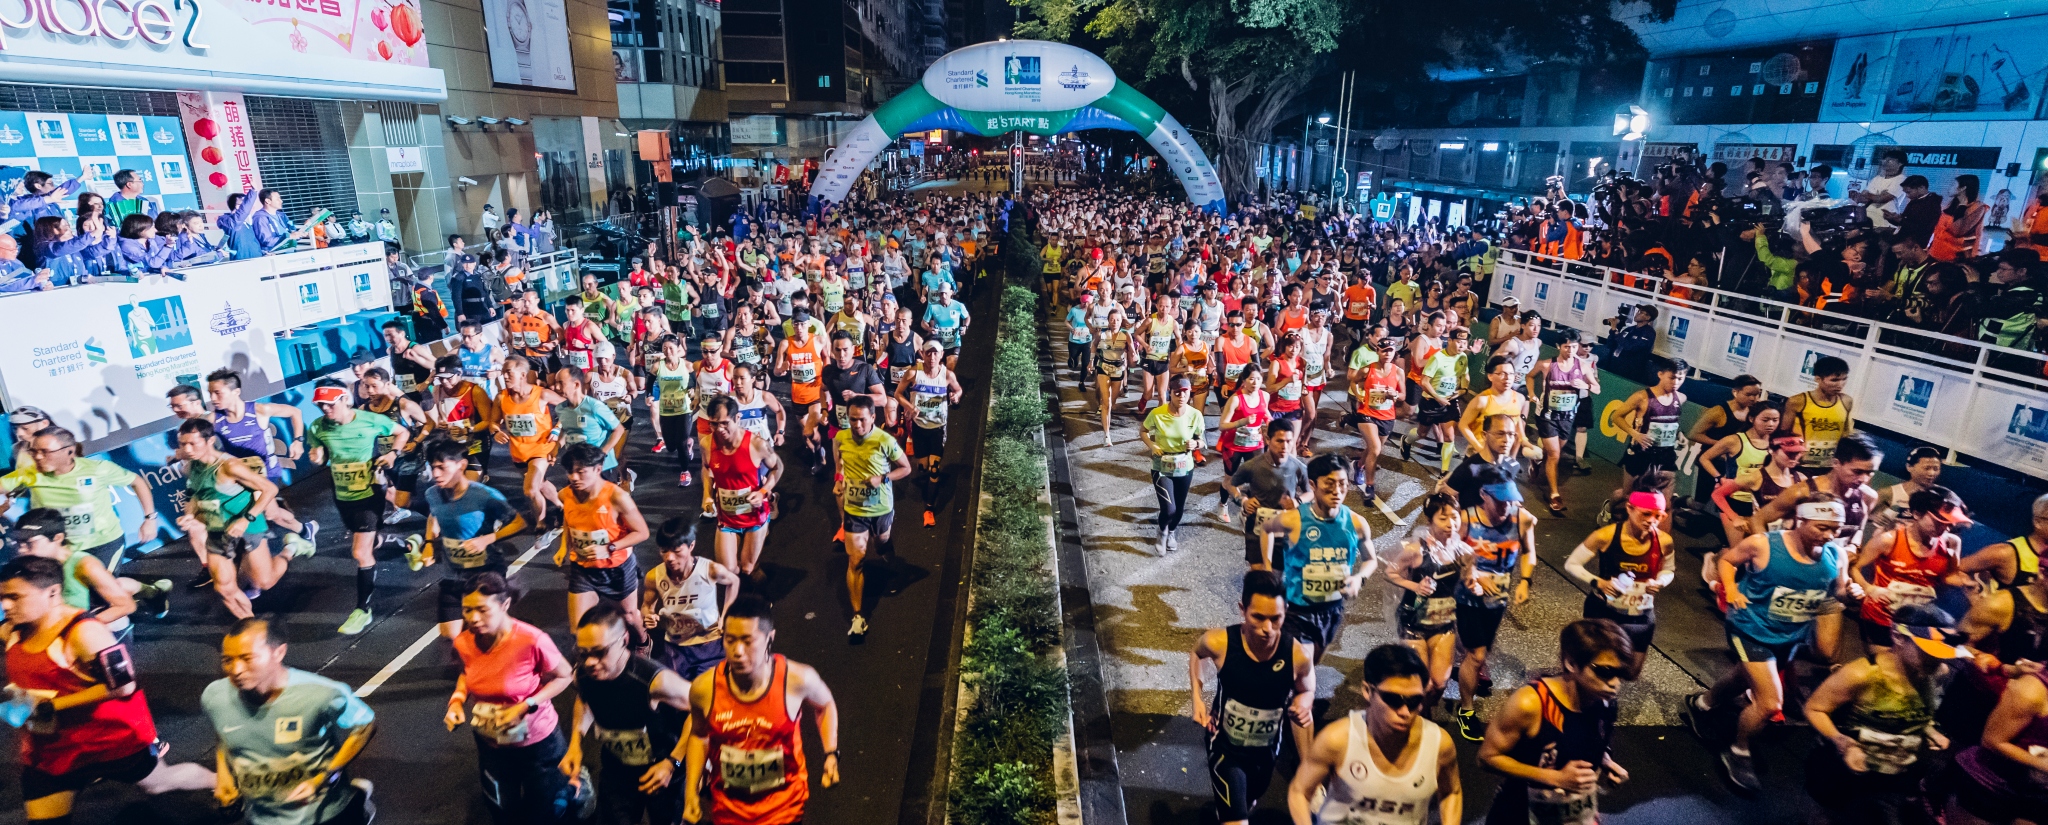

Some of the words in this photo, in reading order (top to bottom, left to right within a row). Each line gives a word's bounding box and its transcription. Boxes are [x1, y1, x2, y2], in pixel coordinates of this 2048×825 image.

[945, 76, 974, 84] Chartered
[947, 69, 974, 77] Standard
[987, 117, 999, 130] 起
[1001, 117, 1036, 128] START
[1038, 118, 1050, 130] 點
[33, 340, 79, 357] Standard
[32, 351, 82, 369] Chartered
[134, 357, 165, 372] Standard
[165, 350, 197, 363] Chartered
[48, 361, 85, 377] 渣打銀行
[136, 369, 154, 380] Hong
[154, 364, 171, 375] Kong
[171, 358, 199, 371] Marathon
[1551, 396, 1575, 404] 52157
[508, 420, 533, 429] 57311
[849, 487, 878, 497] 57493
[1226, 714, 1274, 734] 52126
